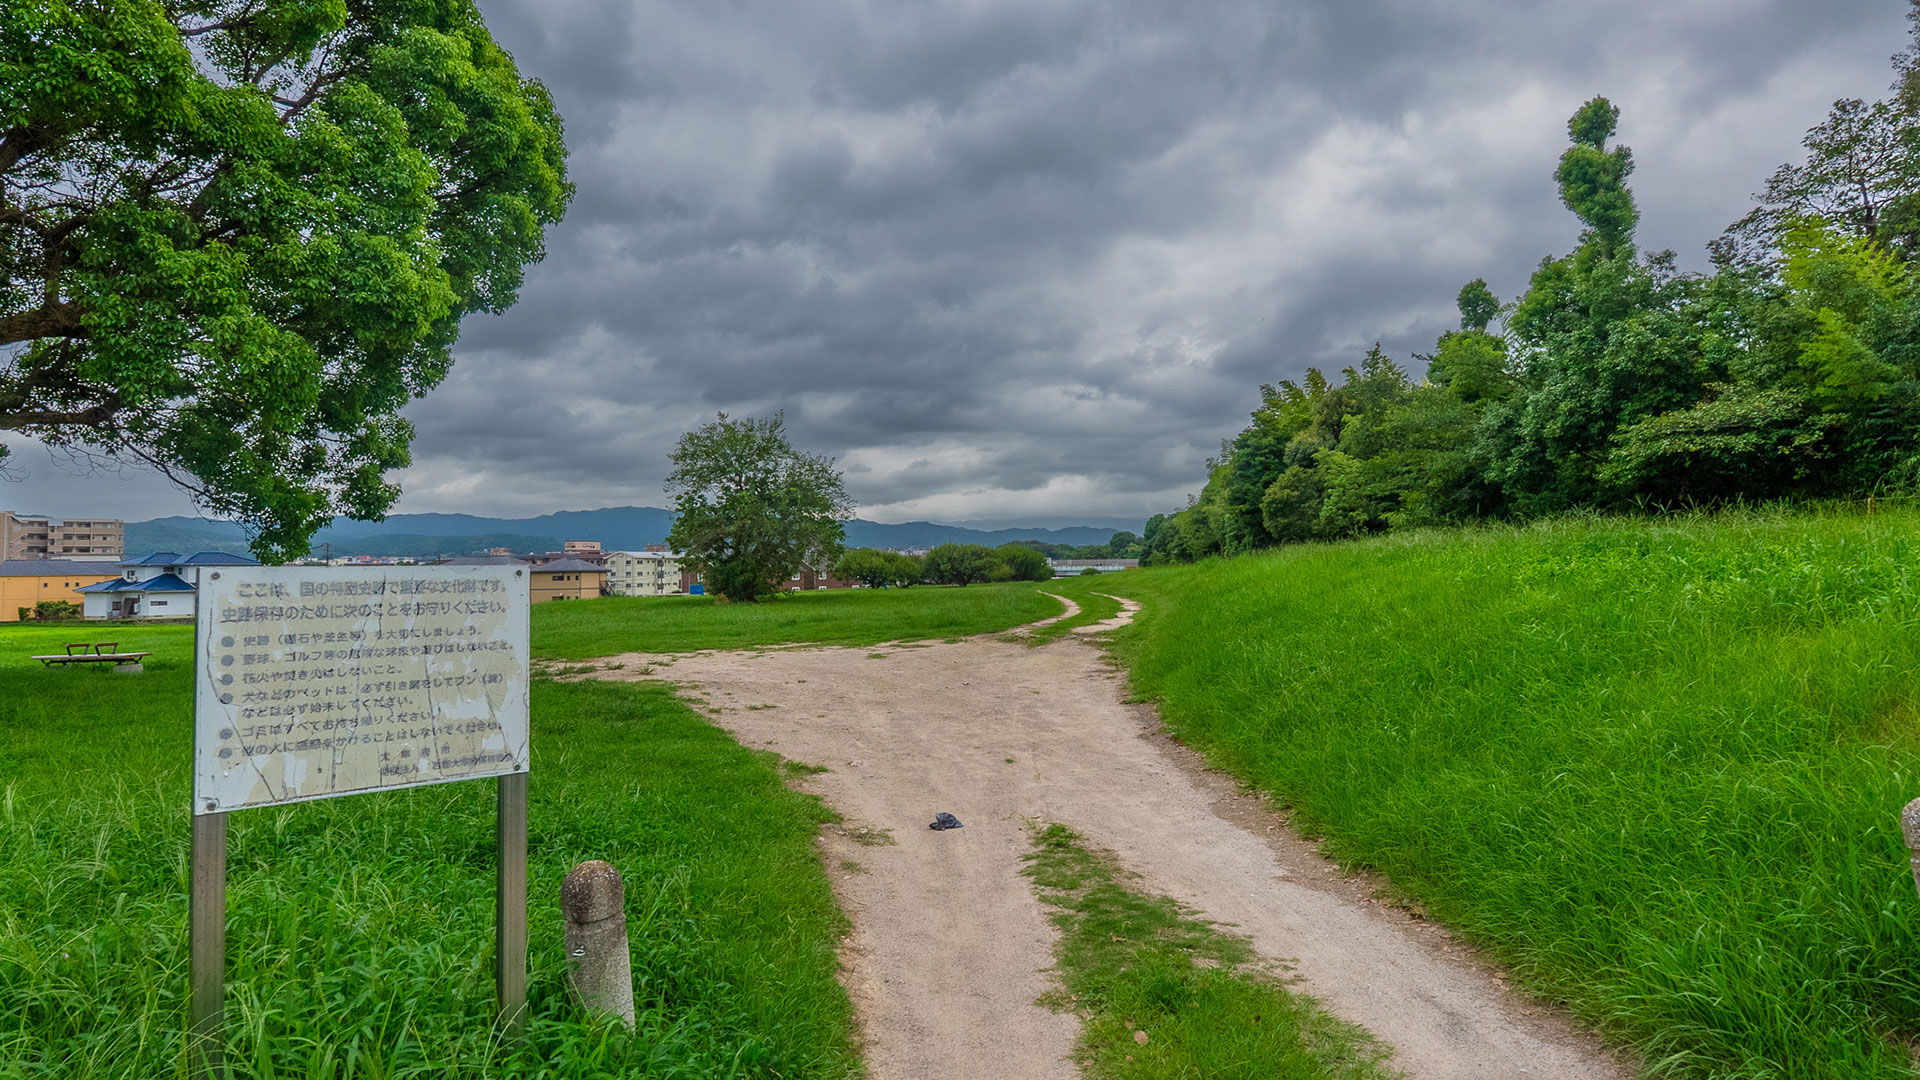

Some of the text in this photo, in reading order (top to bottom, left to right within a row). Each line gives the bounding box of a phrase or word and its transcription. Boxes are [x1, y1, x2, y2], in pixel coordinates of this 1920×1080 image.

[221, 600, 507, 623] 史跡保存のために次のことをお守りください。
[242, 711, 436, 738] ゴミはすべてお持ち帰りください
